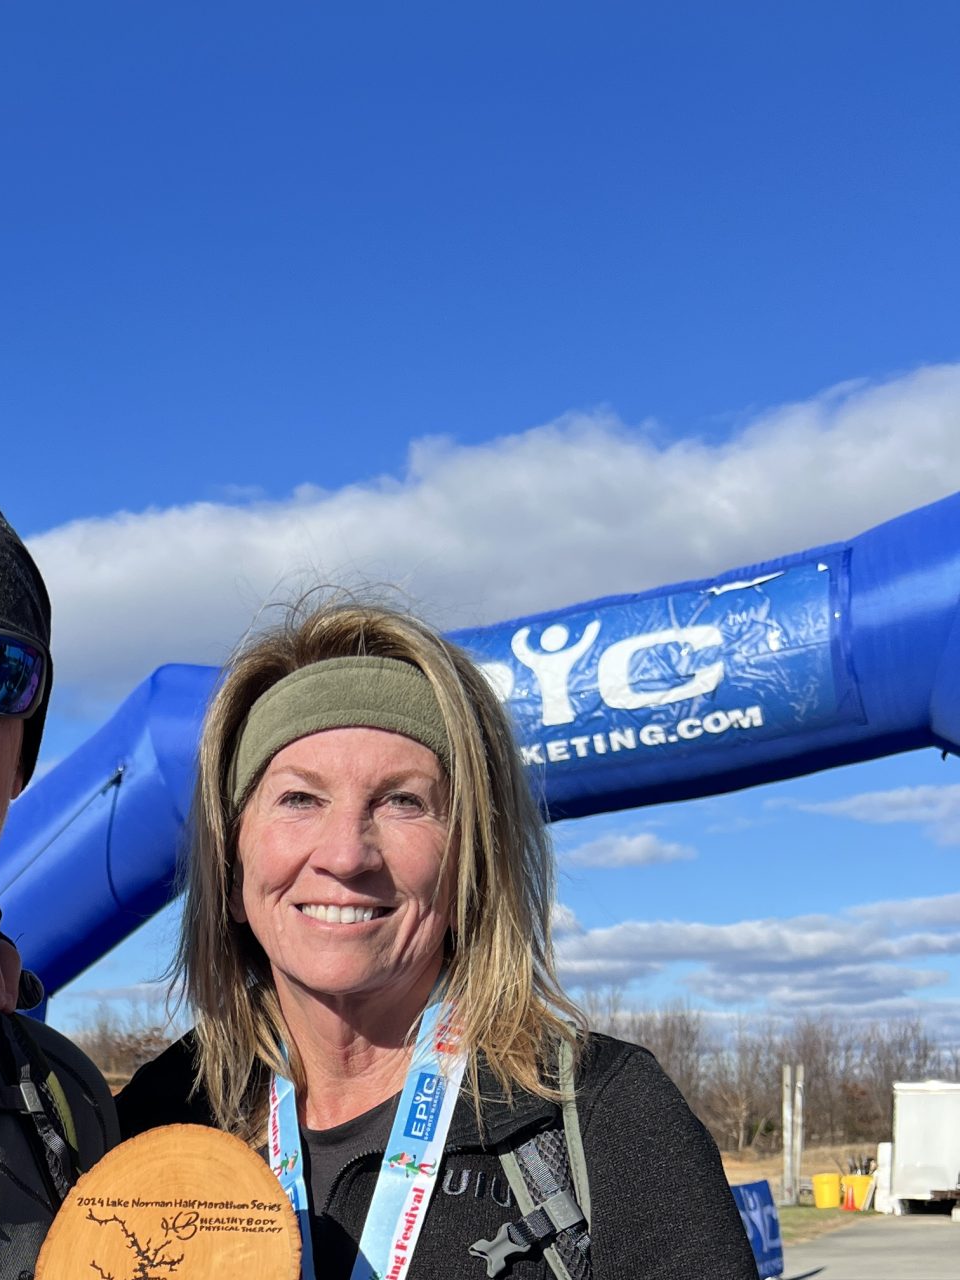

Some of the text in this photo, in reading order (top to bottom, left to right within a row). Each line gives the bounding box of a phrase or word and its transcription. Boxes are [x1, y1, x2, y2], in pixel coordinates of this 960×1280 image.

[478, 620, 724, 726] YC
[77, 1197, 104, 1207] 2024
[106, 1197, 129, 1208] Lake
[132, 1197, 173, 1208] Norman
[174, 1199, 197, 1209] Half
[250, 1199, 282, 1212] Series
[200, 1217, 277, 1226] HEALTHY BODY
[395, 1187, 425, 1251] Festival
